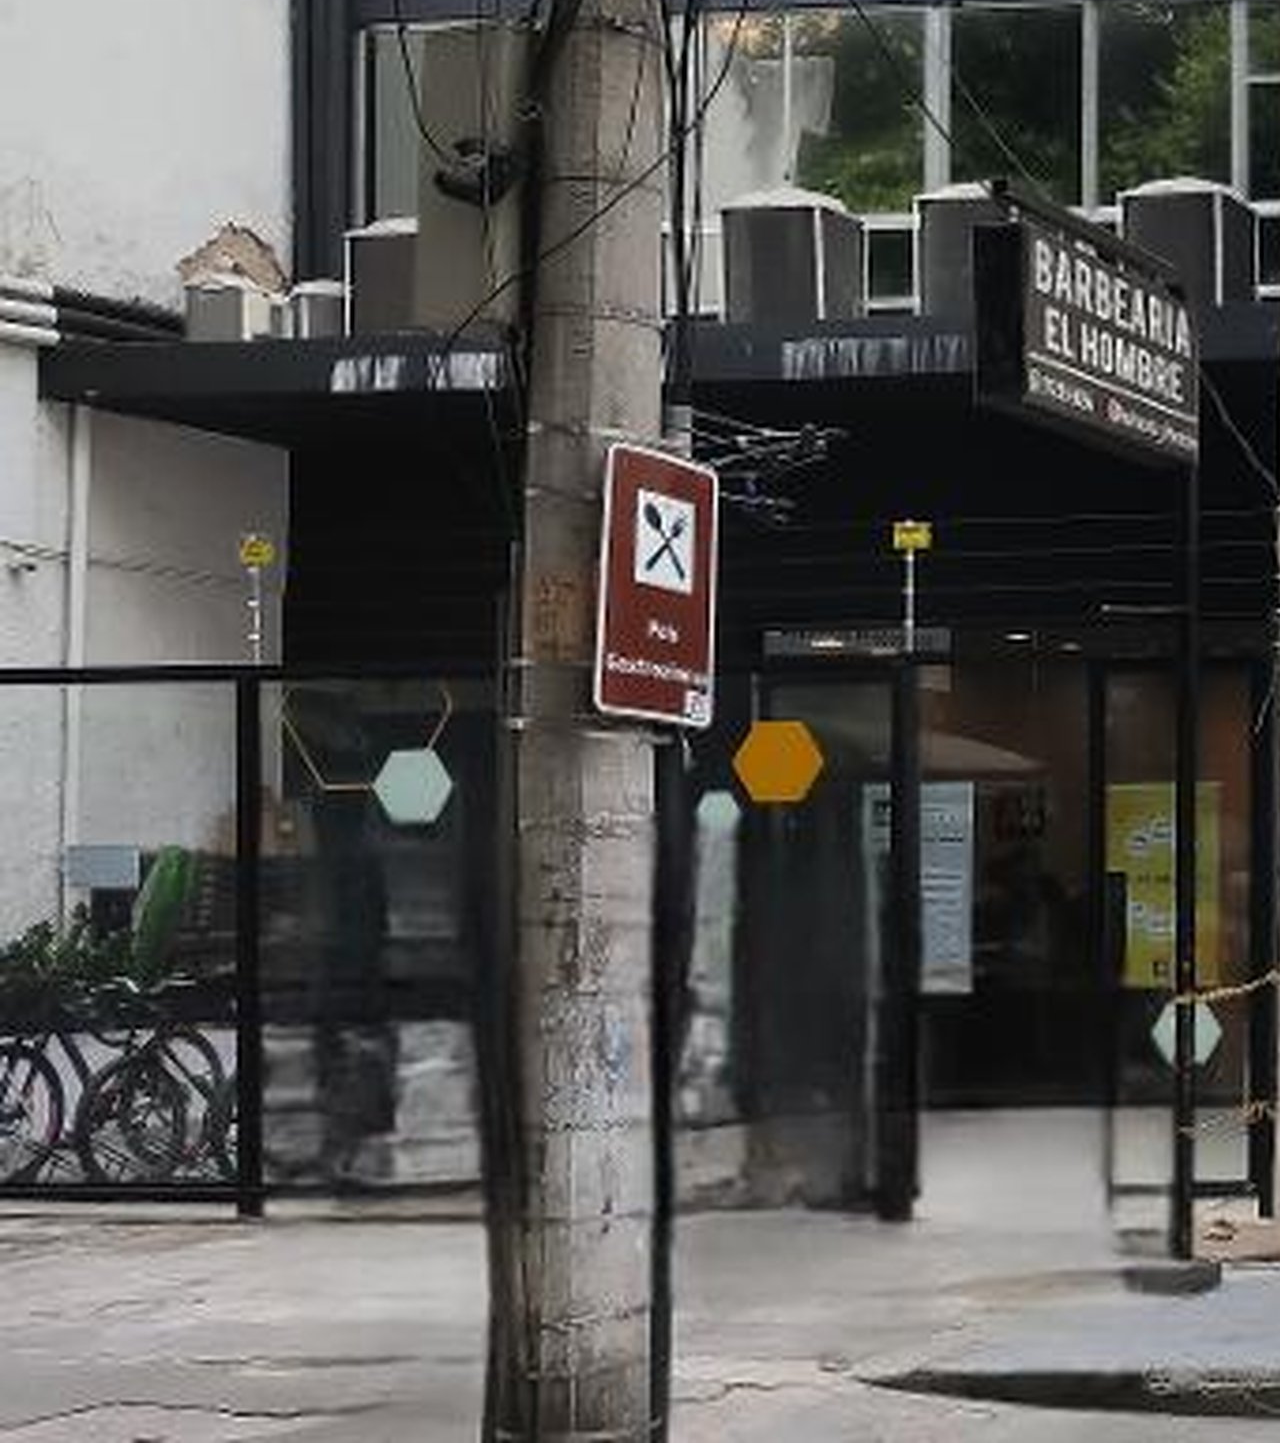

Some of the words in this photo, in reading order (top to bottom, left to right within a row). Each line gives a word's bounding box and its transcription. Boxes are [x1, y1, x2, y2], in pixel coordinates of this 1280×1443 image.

[1035, 239, 1191, 358] BARBEARIA
[1044, 306, 1076, 358] EL
[1081, 322, 1185, 403] HOMBRE
